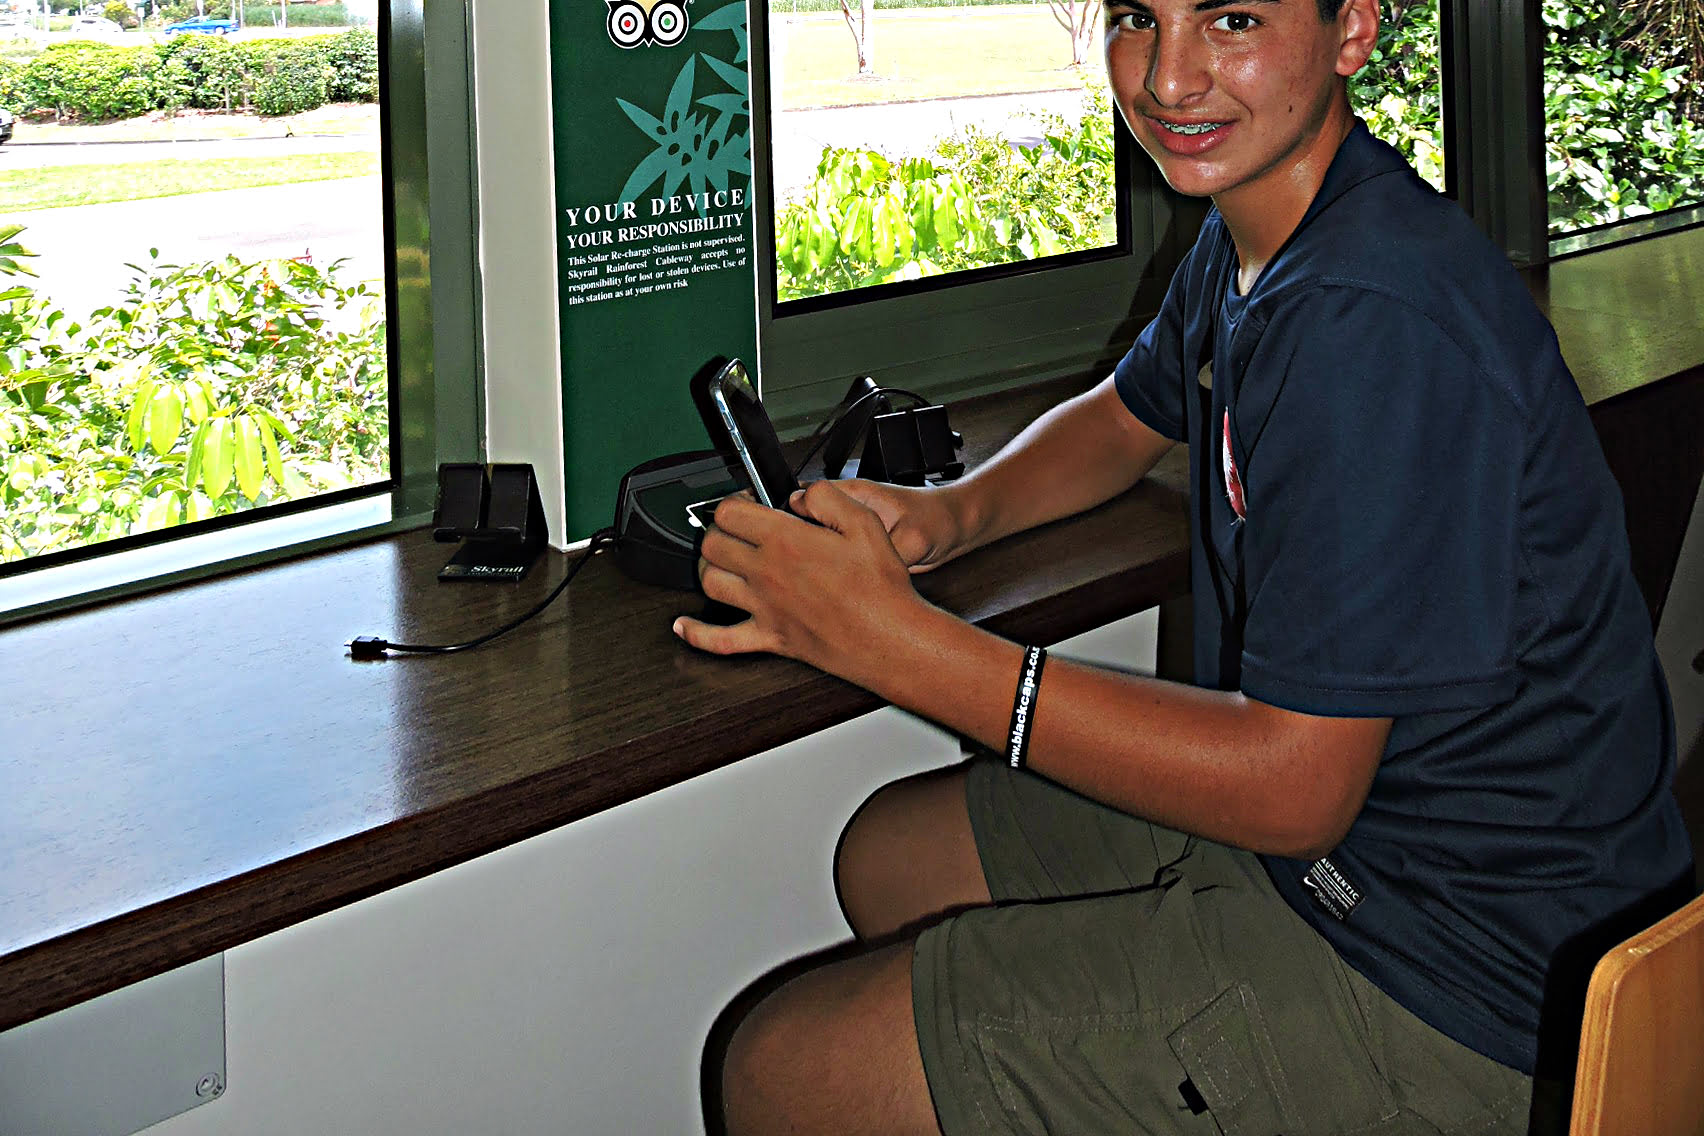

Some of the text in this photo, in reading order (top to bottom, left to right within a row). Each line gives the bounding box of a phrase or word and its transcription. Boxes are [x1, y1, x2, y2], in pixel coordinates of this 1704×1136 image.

[566, 188, 744, 227] YOUR DEVICE
[567, 212, 744, 249] YOUR RESPONSIBILITY
[568, 234, 745, 266] This Solar Re-charge Station is not supervised.
[568, 246, 746, 281] Skyrail Rainforest Cableway accepts no
[568, 257, 746, 293] responsibility for lost or stolen devices. Use of
[569, 278, 689, 306] this station as at your own risk
[470, 566, 524, 574] Skyrail
[1320, 857, 1360, 900] AUTHENTIC
